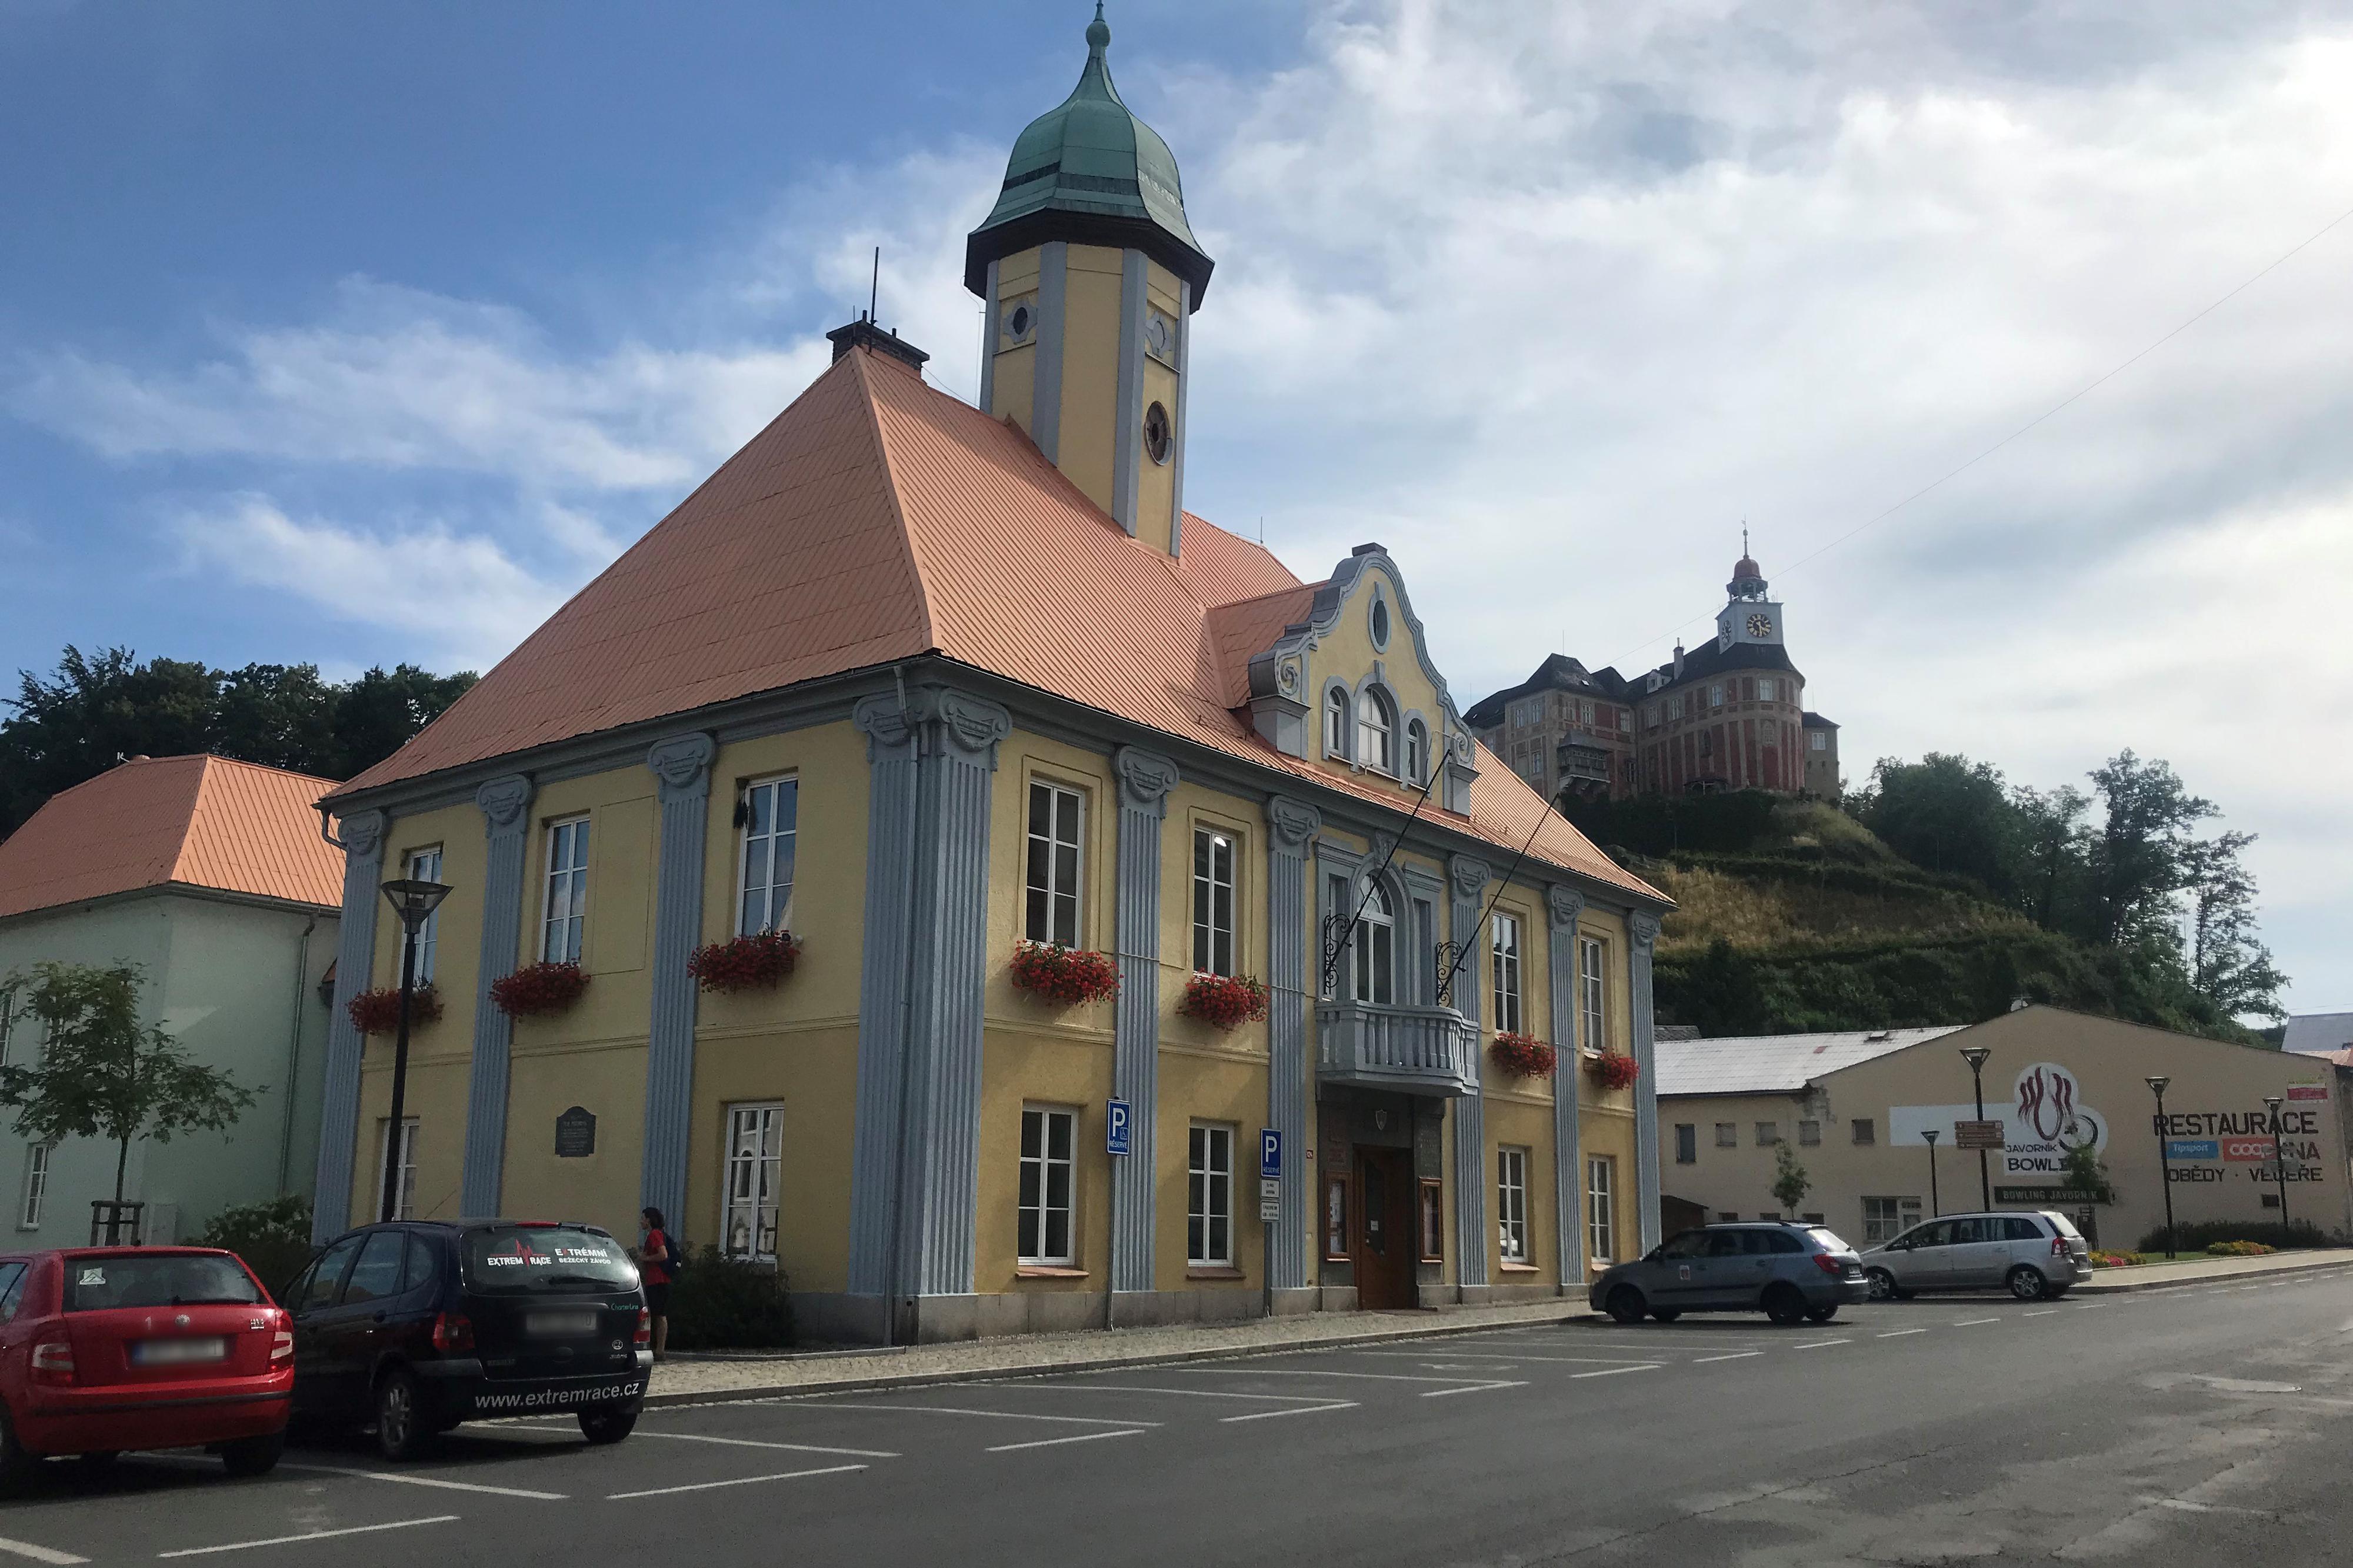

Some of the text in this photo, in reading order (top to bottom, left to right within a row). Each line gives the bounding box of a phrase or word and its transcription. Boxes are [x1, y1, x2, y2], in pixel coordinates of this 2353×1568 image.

[1112, 1107, 1125, 1137] P
[2153, 1111, 2318, 1136] RESTAURACE
[1265, 1135, 1277, 1162] P
[2006, 1142, 2057, 1153] JAVORNÍK
[2168, 1165, 2225, 1182] OBĚDY
[2003, 1190, 2045, 1200] BOWLING
[487, 1257, 552, 1266] EXTREM RACE
[475, 1383, 639, 1407] www.extremrace.cz
